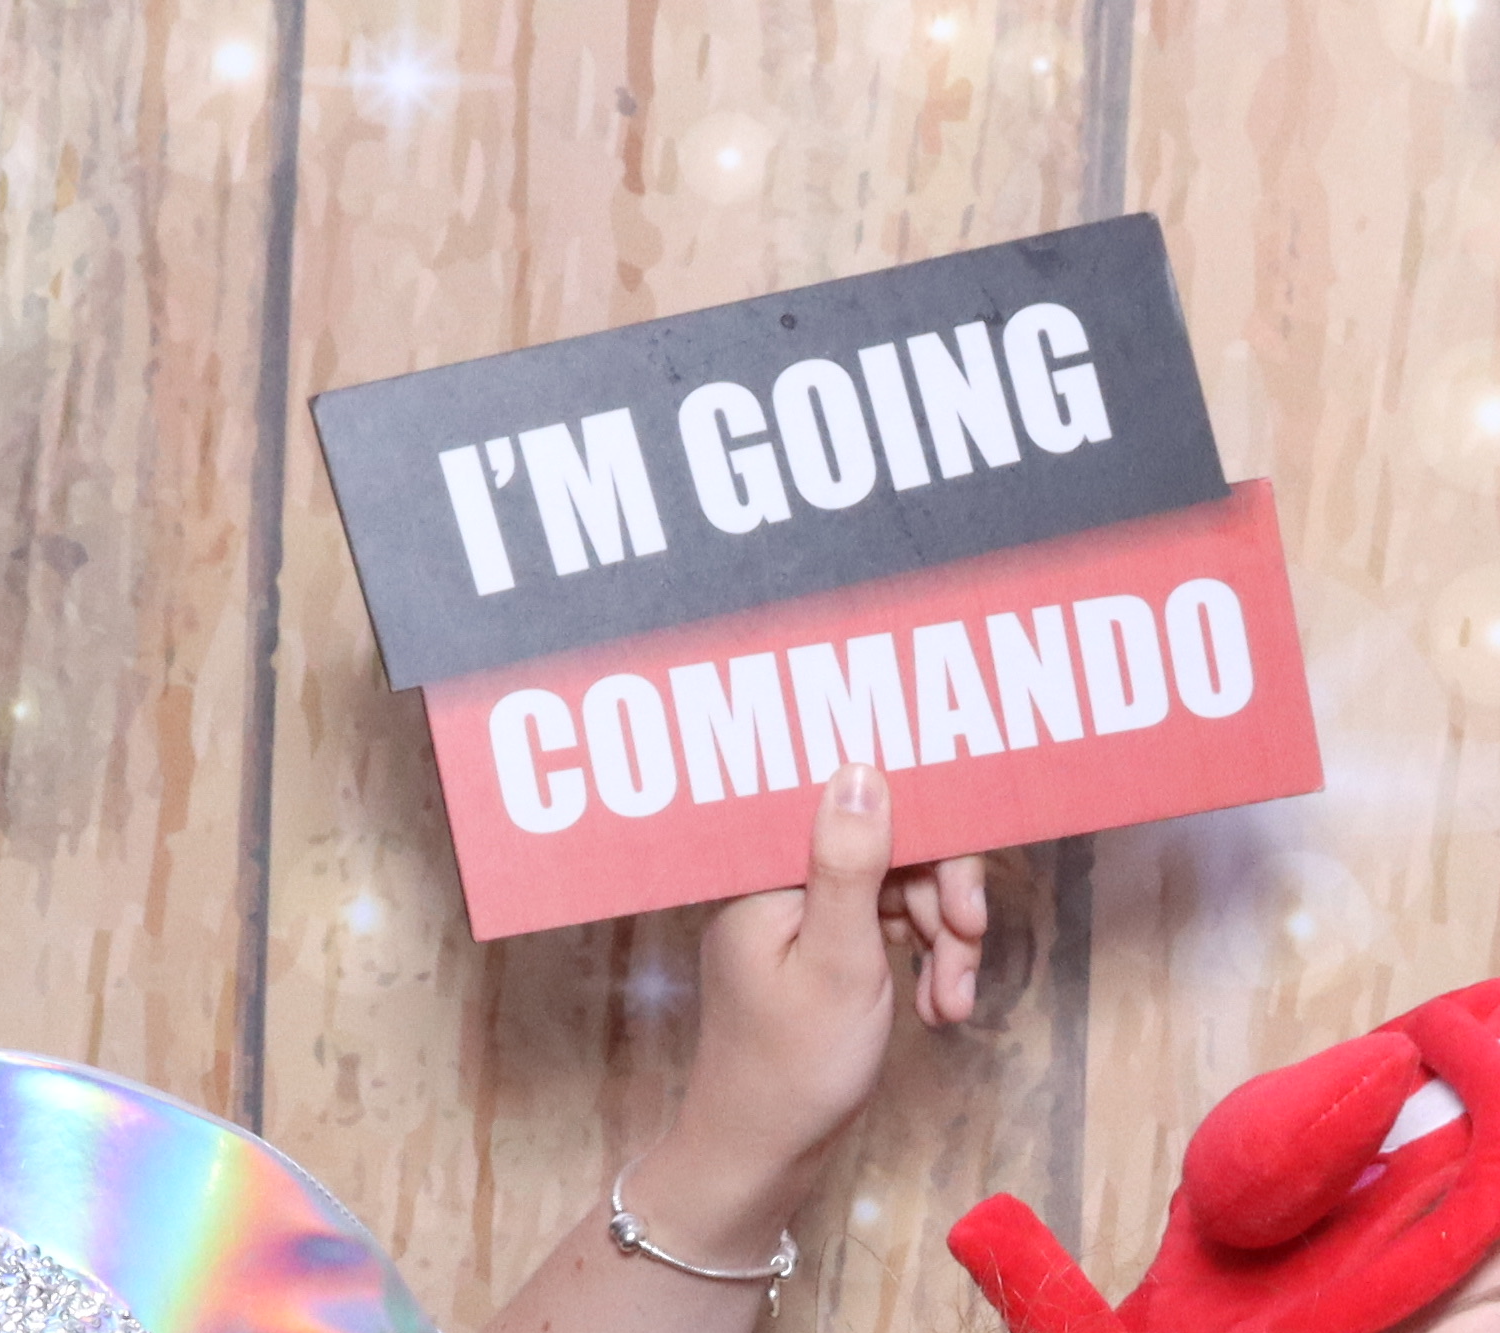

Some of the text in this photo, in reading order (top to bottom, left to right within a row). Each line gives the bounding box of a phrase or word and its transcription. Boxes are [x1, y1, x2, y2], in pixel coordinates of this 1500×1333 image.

[438, 303, 1113, 597] I'M GOING
[488, 578, 1255, 835] COMMANDO
